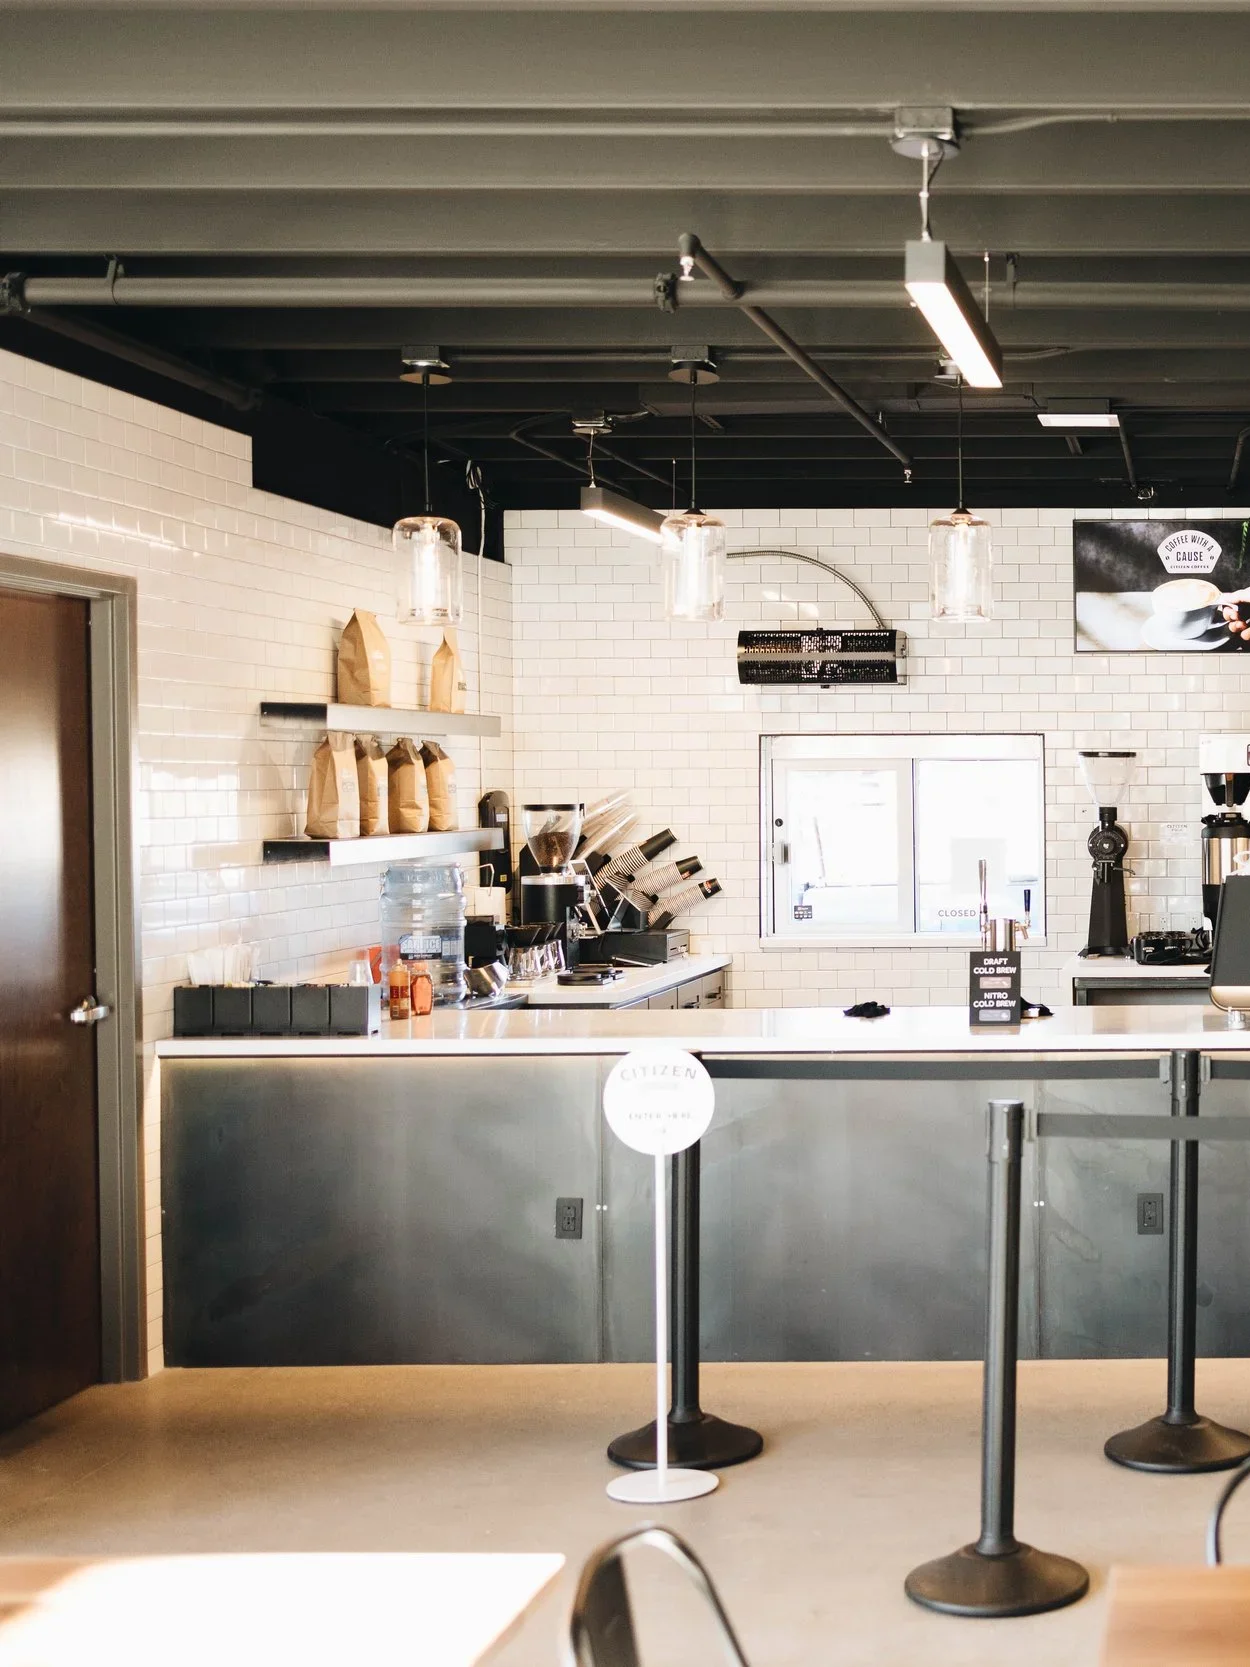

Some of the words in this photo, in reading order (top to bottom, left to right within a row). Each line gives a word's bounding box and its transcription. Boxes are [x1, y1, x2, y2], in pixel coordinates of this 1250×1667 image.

[1165, 535, 1188, 552] COFFEE
[1191, 535, 1209, 547] WITH
[1176, 551, 1203, 561] CAUSE
[938, 909, 977, 917] CLOSED
[973, 1000, 994, 1008] COLD
[995, 1000, 1016, 1008] BREW
[620, 1065, 697, 1081] CITIZEN
